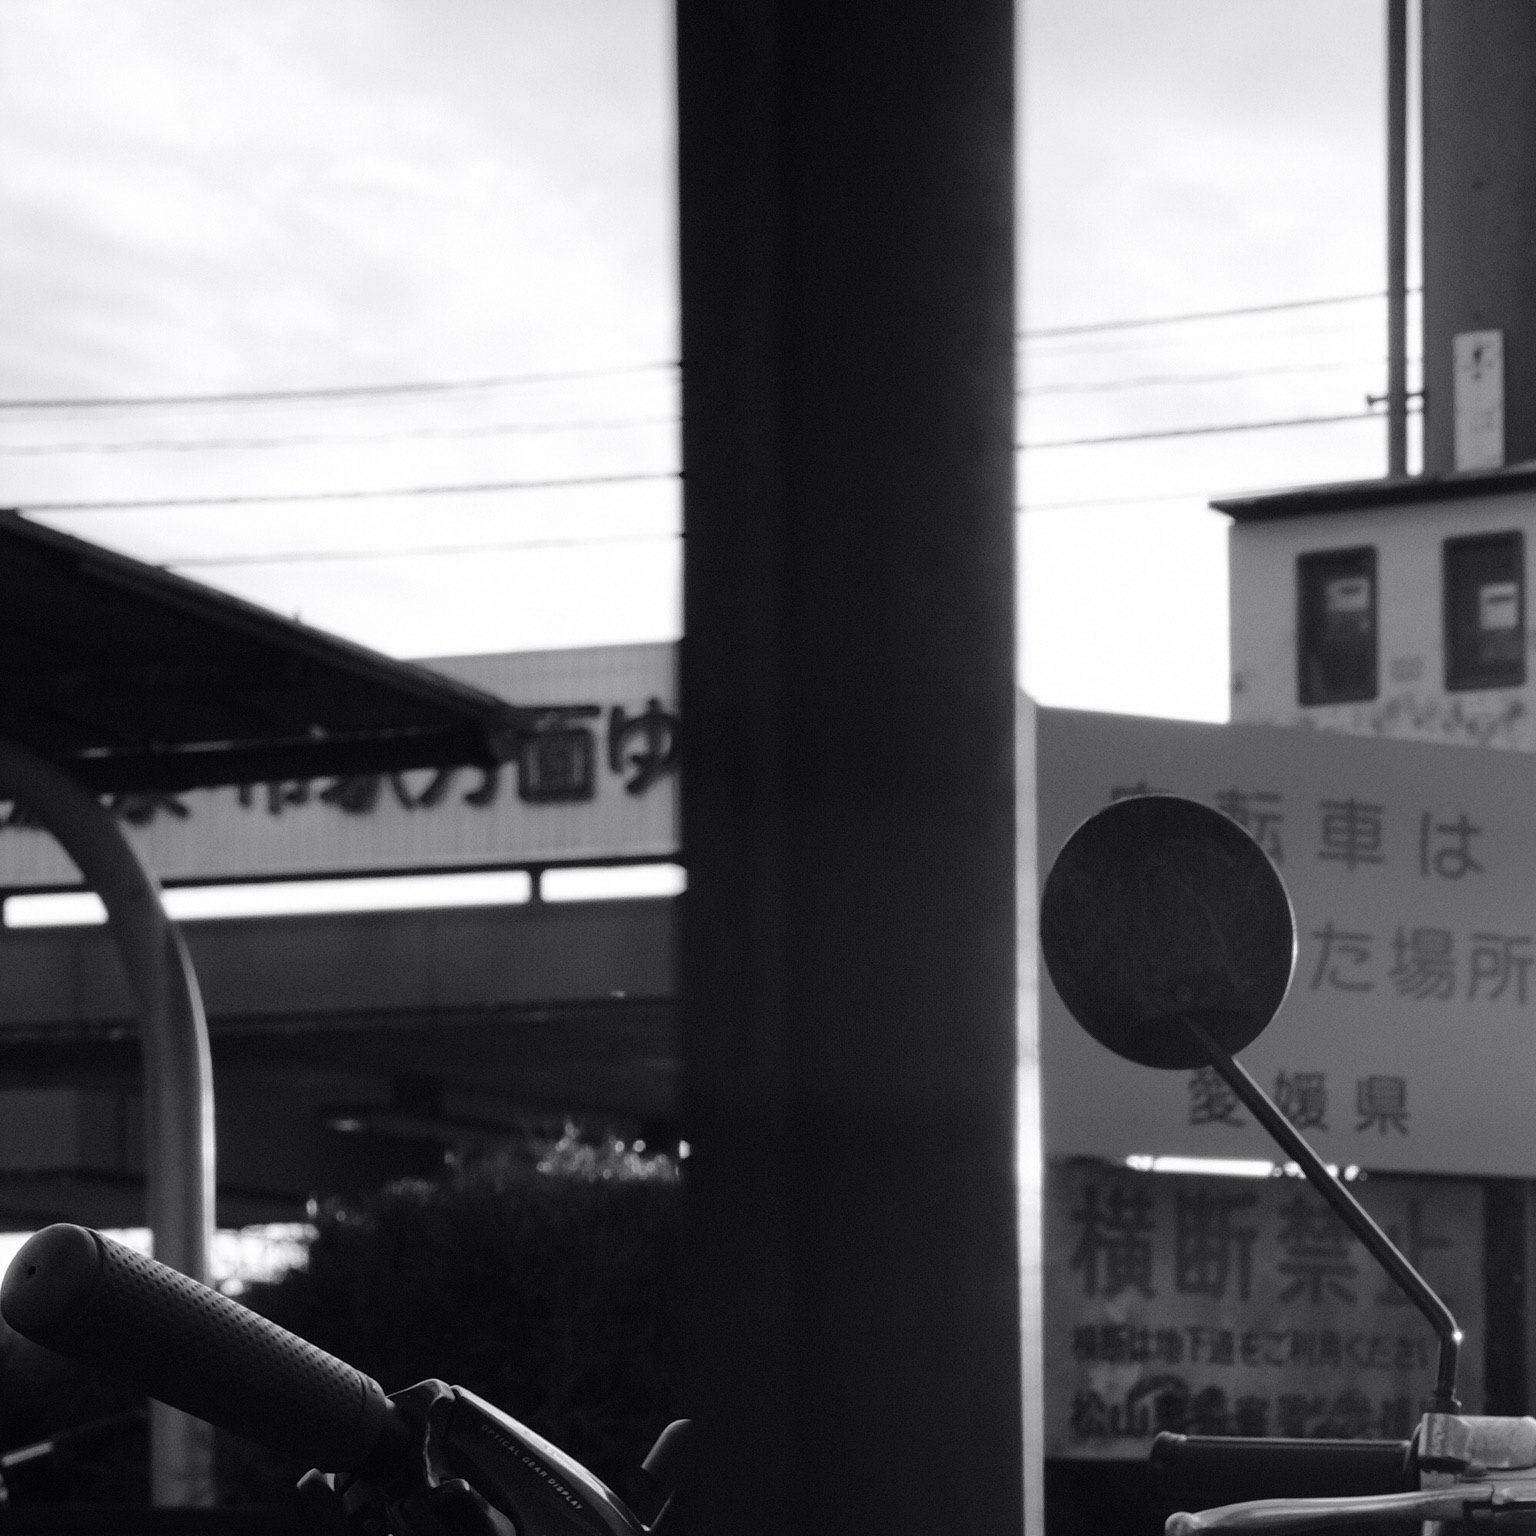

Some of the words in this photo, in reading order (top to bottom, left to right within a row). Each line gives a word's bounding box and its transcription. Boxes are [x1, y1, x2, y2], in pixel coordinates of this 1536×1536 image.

[1187, 1068, 1411, 1136] 愛媛県
[1070, 1184, 1454, 1306] 横断禁止
[481, 1424, 520, 1457] OPTICAL
[521, 1456, 549, 1478] GEAR
[547, 1477, 584, 1510] DISPLAY
